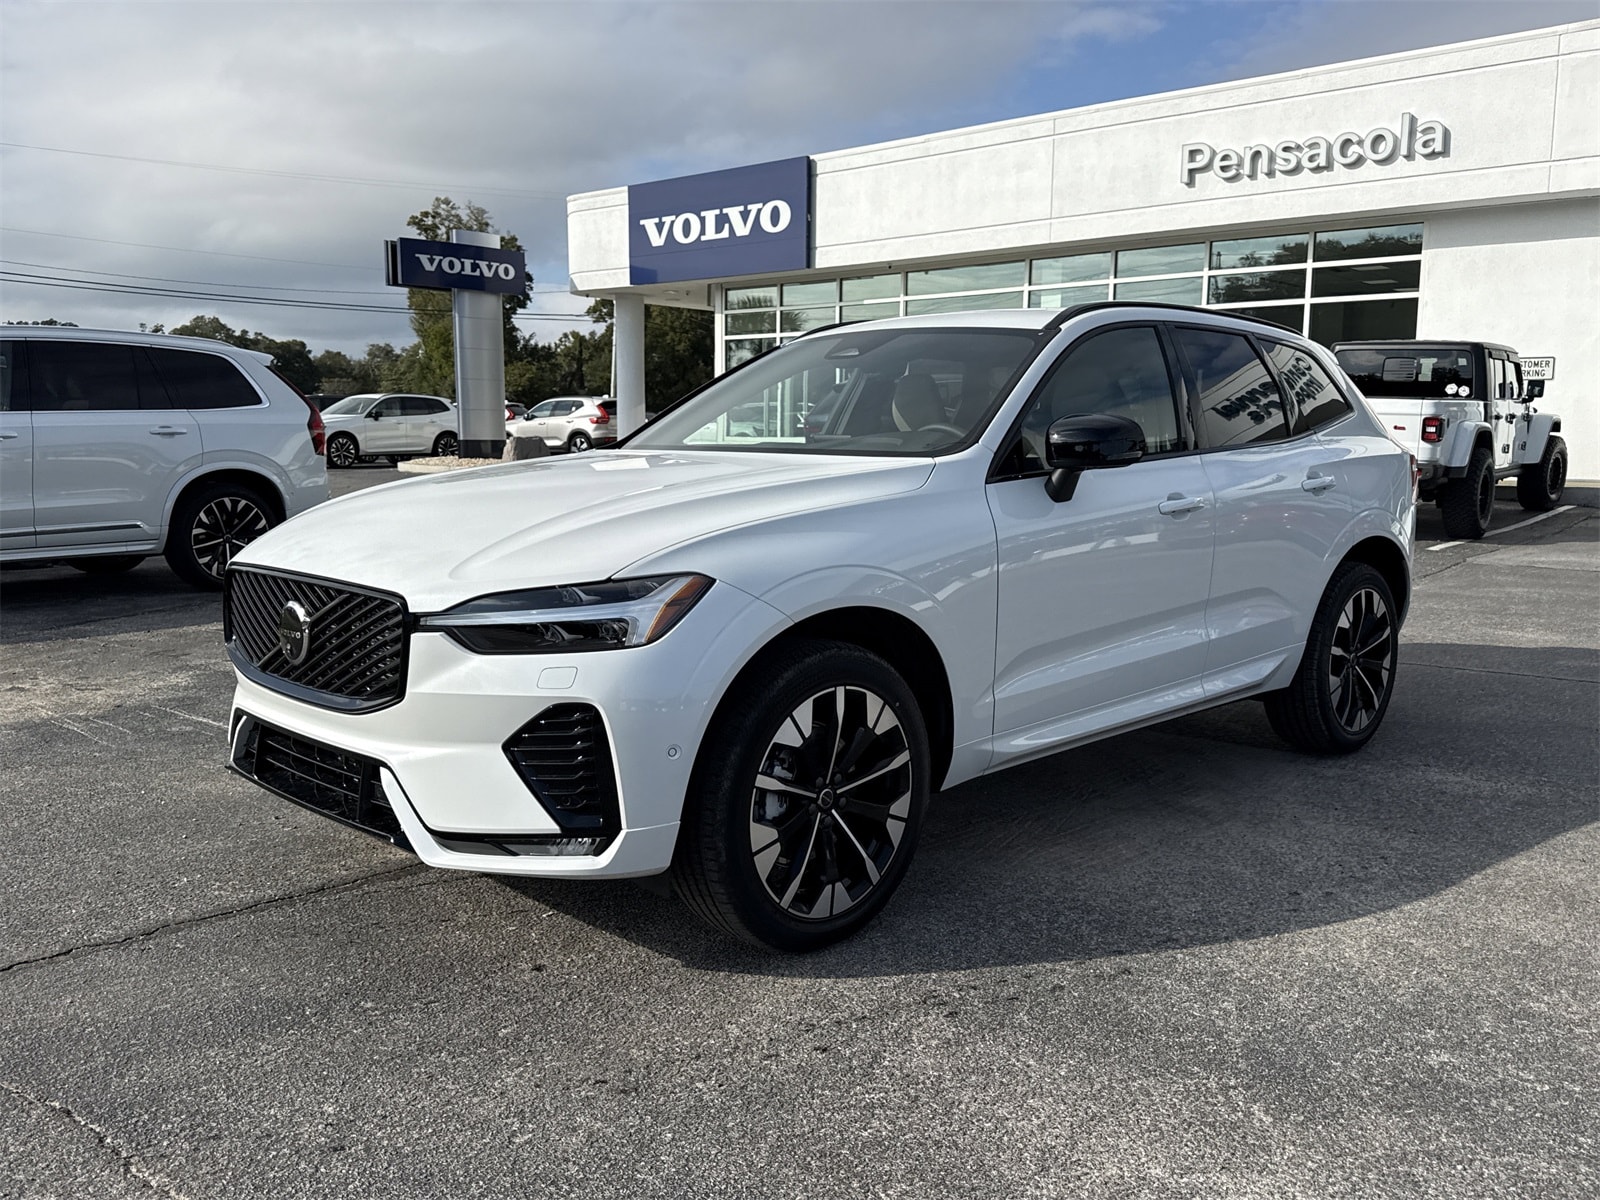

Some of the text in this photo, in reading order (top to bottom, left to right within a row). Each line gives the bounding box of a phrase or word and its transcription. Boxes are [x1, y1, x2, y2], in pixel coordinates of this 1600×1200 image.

[1180, 112, 1451, 188] Pensacola
[639, 199, 792, 247] VOLVO
[415, 253, 516, 281] VOLVO
[1520, 360, 1550, 368] STOMER
[1522, 369, 1546, 377] RKING
